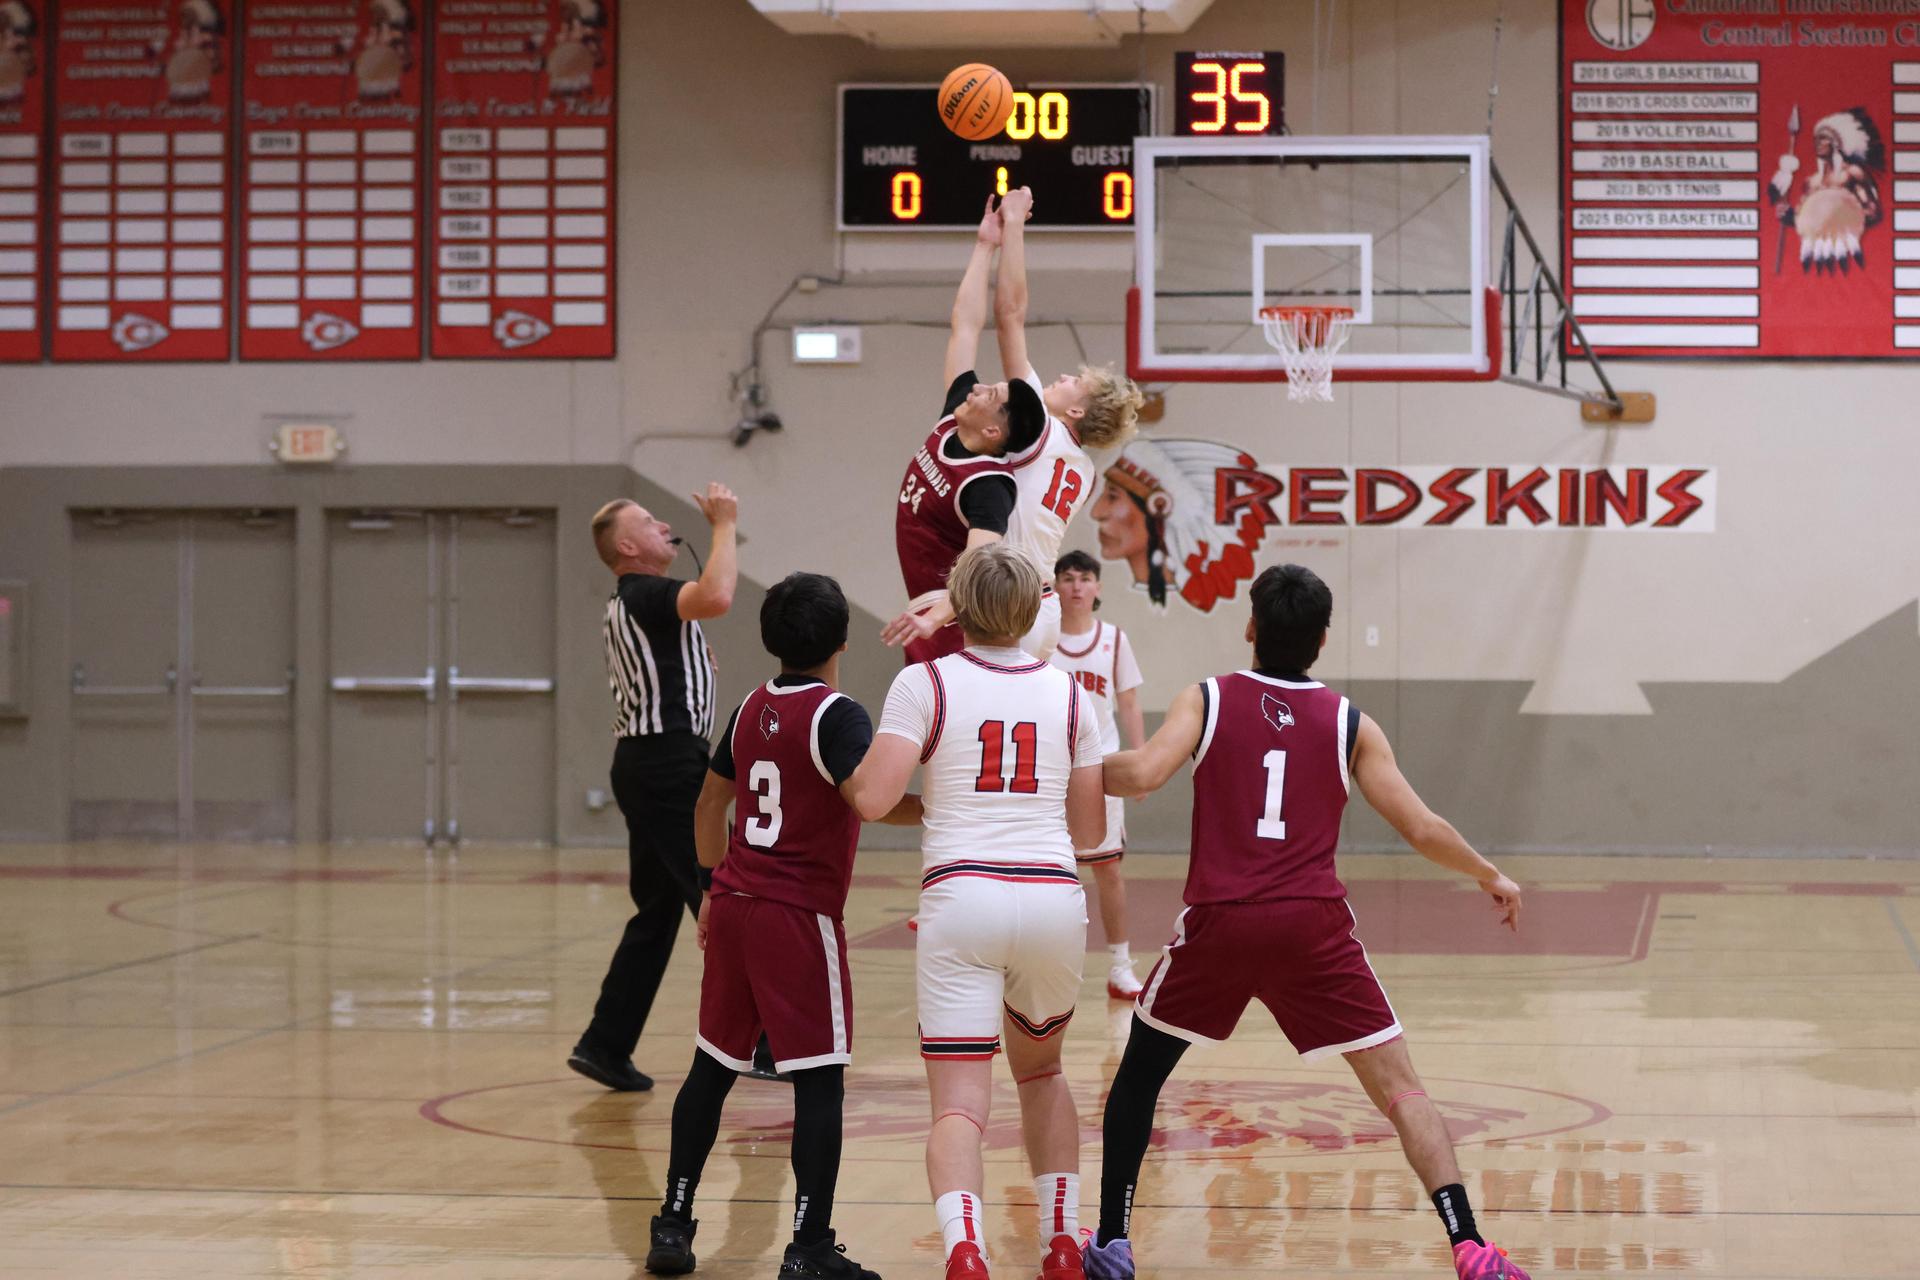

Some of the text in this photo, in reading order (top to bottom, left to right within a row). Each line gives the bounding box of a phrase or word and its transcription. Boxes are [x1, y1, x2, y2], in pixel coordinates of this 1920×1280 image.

[1702, 21, 1791, 46] Central
[1798, 21, 1887, 46] Section
[1580, 67, 1748, 80] 2018 GIRLS BASKETBALL
[943, 77, 978, 120] Wilson
[1192, 63, 1269, 131] 35
[1605, 96, 1641, 109] BOYS
[1644, 96, 1688, 109] CROSS
[1691, 96, 1751, 109] COUNTRY
[1596, 125, 1734, 138] 2018 VOLLEYBALL
[863, 146, 917, 166] HOME
[970, 144, 1022, 160] PERIOD
[1071, 146, 1132, 166] GUEST
[1602, 155, 1729, 169] 2019 BASEBALL
[893, 173, 921, 219] 0
[1104, 173, 1132, 219] 0
[1637, 183, 1672, 195] BOYS
[1678, 183, 1721, 195] TENNIS
[1614, 213, 1654, 226] BOYS
[1658, 213, 1757, 226] BASKETBALL
[915, 445, 951, 498] CARDINALS
[900, 473, 927, 515] 34
[1041, 457, 1082, 525] 12
[1214, 466, 1709, 527] REDSKINS
[1075, 671, 1107, 699] IBE
[975, 719, 1039, 793] 11
[745, 760, 783, 849] 3
[1256, 749, 1287, 841] 1
